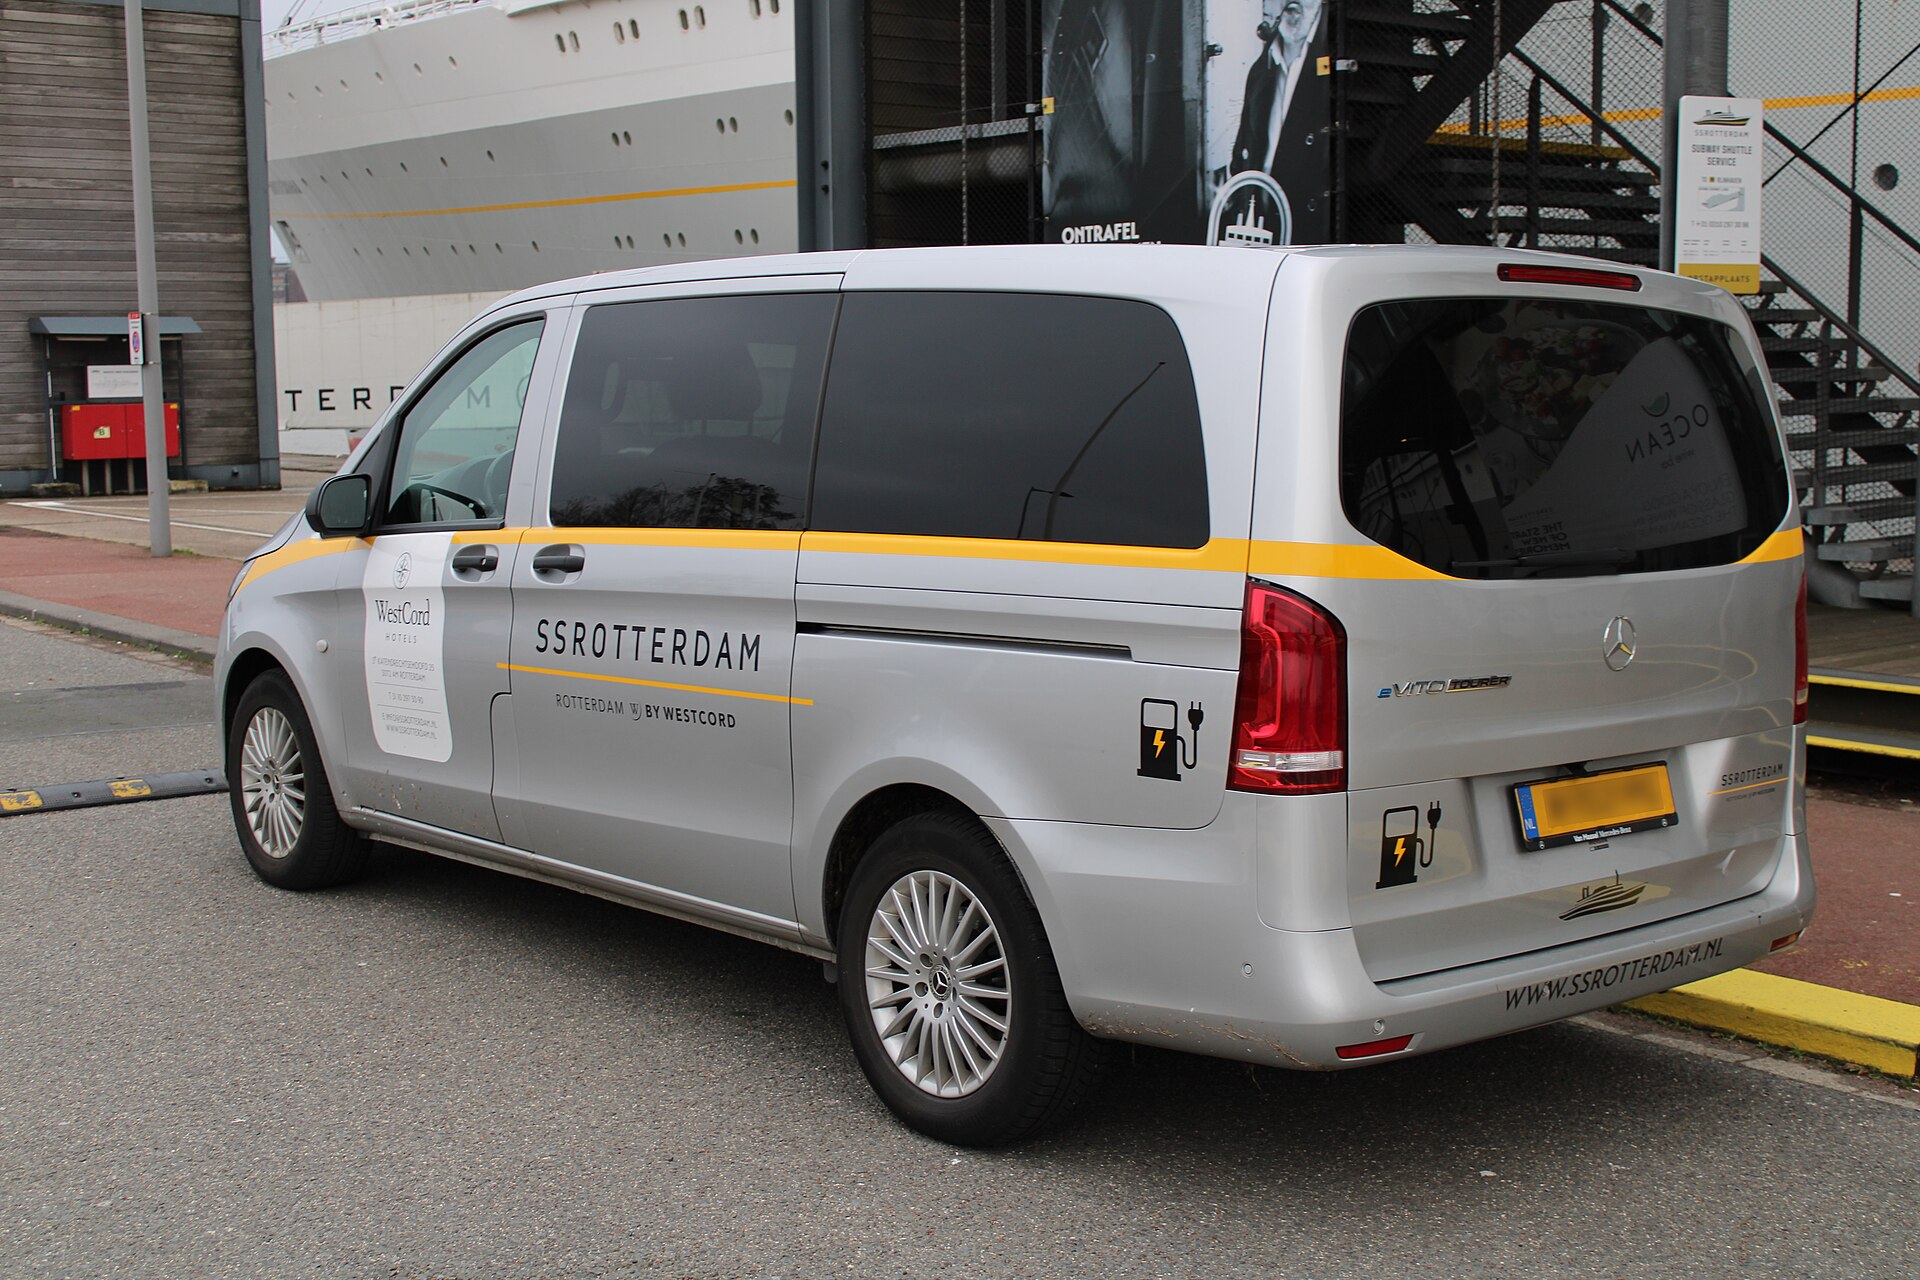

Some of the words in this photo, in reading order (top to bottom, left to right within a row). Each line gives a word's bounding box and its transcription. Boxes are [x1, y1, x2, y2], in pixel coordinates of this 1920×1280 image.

[1691, 144, 1720, 153] SUBWAY
[1722, 145, 1752, 155] SHUTTLE
[1707, 157, 1736, 167] SERVICE
[1061, 222, 1140, 244] ONTRAFEL
[375, 598, 430, 626] WestCord
[385, 633, 417, 644] HOTELS
[535, 618, 761, 672] SSROTTERDAM
[1449, 675, 1512, 691] TOURER
[555, 694, 624, 715] ROTTERDAM
[645, 704, 660, 719] BY
[662, 706, 736, 728] WESTCORD
[1721, 763, 1784, 786] SSROTTERDAM
[1524, 818, 1537, 830] NL
[1505, 937, 1724, 1011] WWW.SSROTTERDAM.NL
